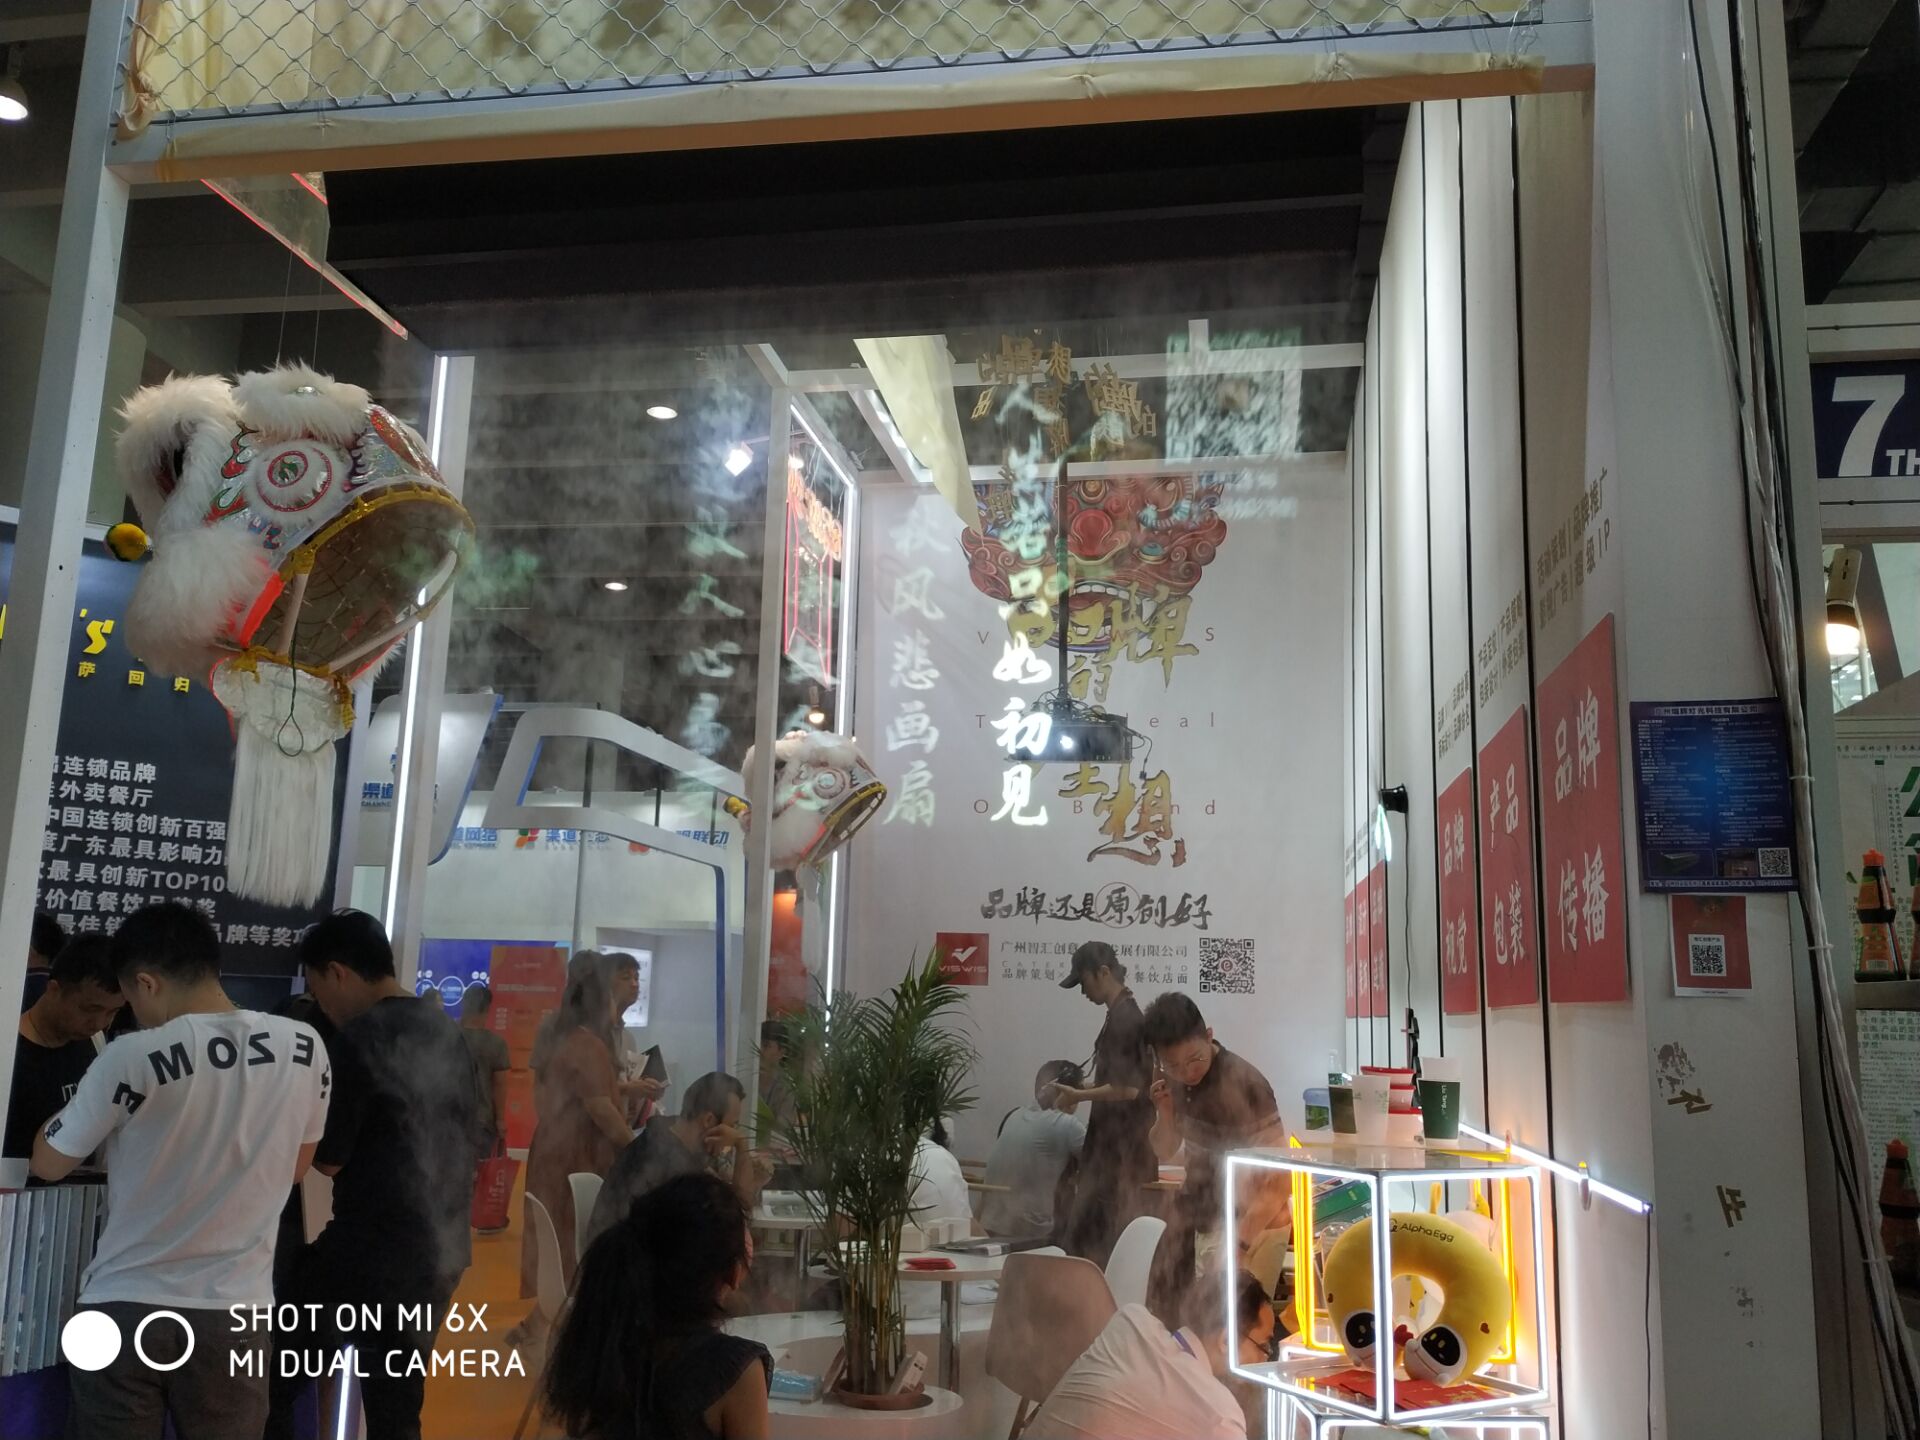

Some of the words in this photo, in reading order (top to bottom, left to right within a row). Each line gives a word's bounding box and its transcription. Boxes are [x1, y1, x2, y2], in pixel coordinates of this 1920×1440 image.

[1832, 375, 1905, 477] 7
[1555, 686, 1601, 803] 品牌
[38, 859, 230, 892] 最具创新TOP10
[43, 830, 229, 866] 度广东最具影响力
[980, 885, 1213, 931] 品牌还是原创好
[1558, 845, 1610, 952] 传播
